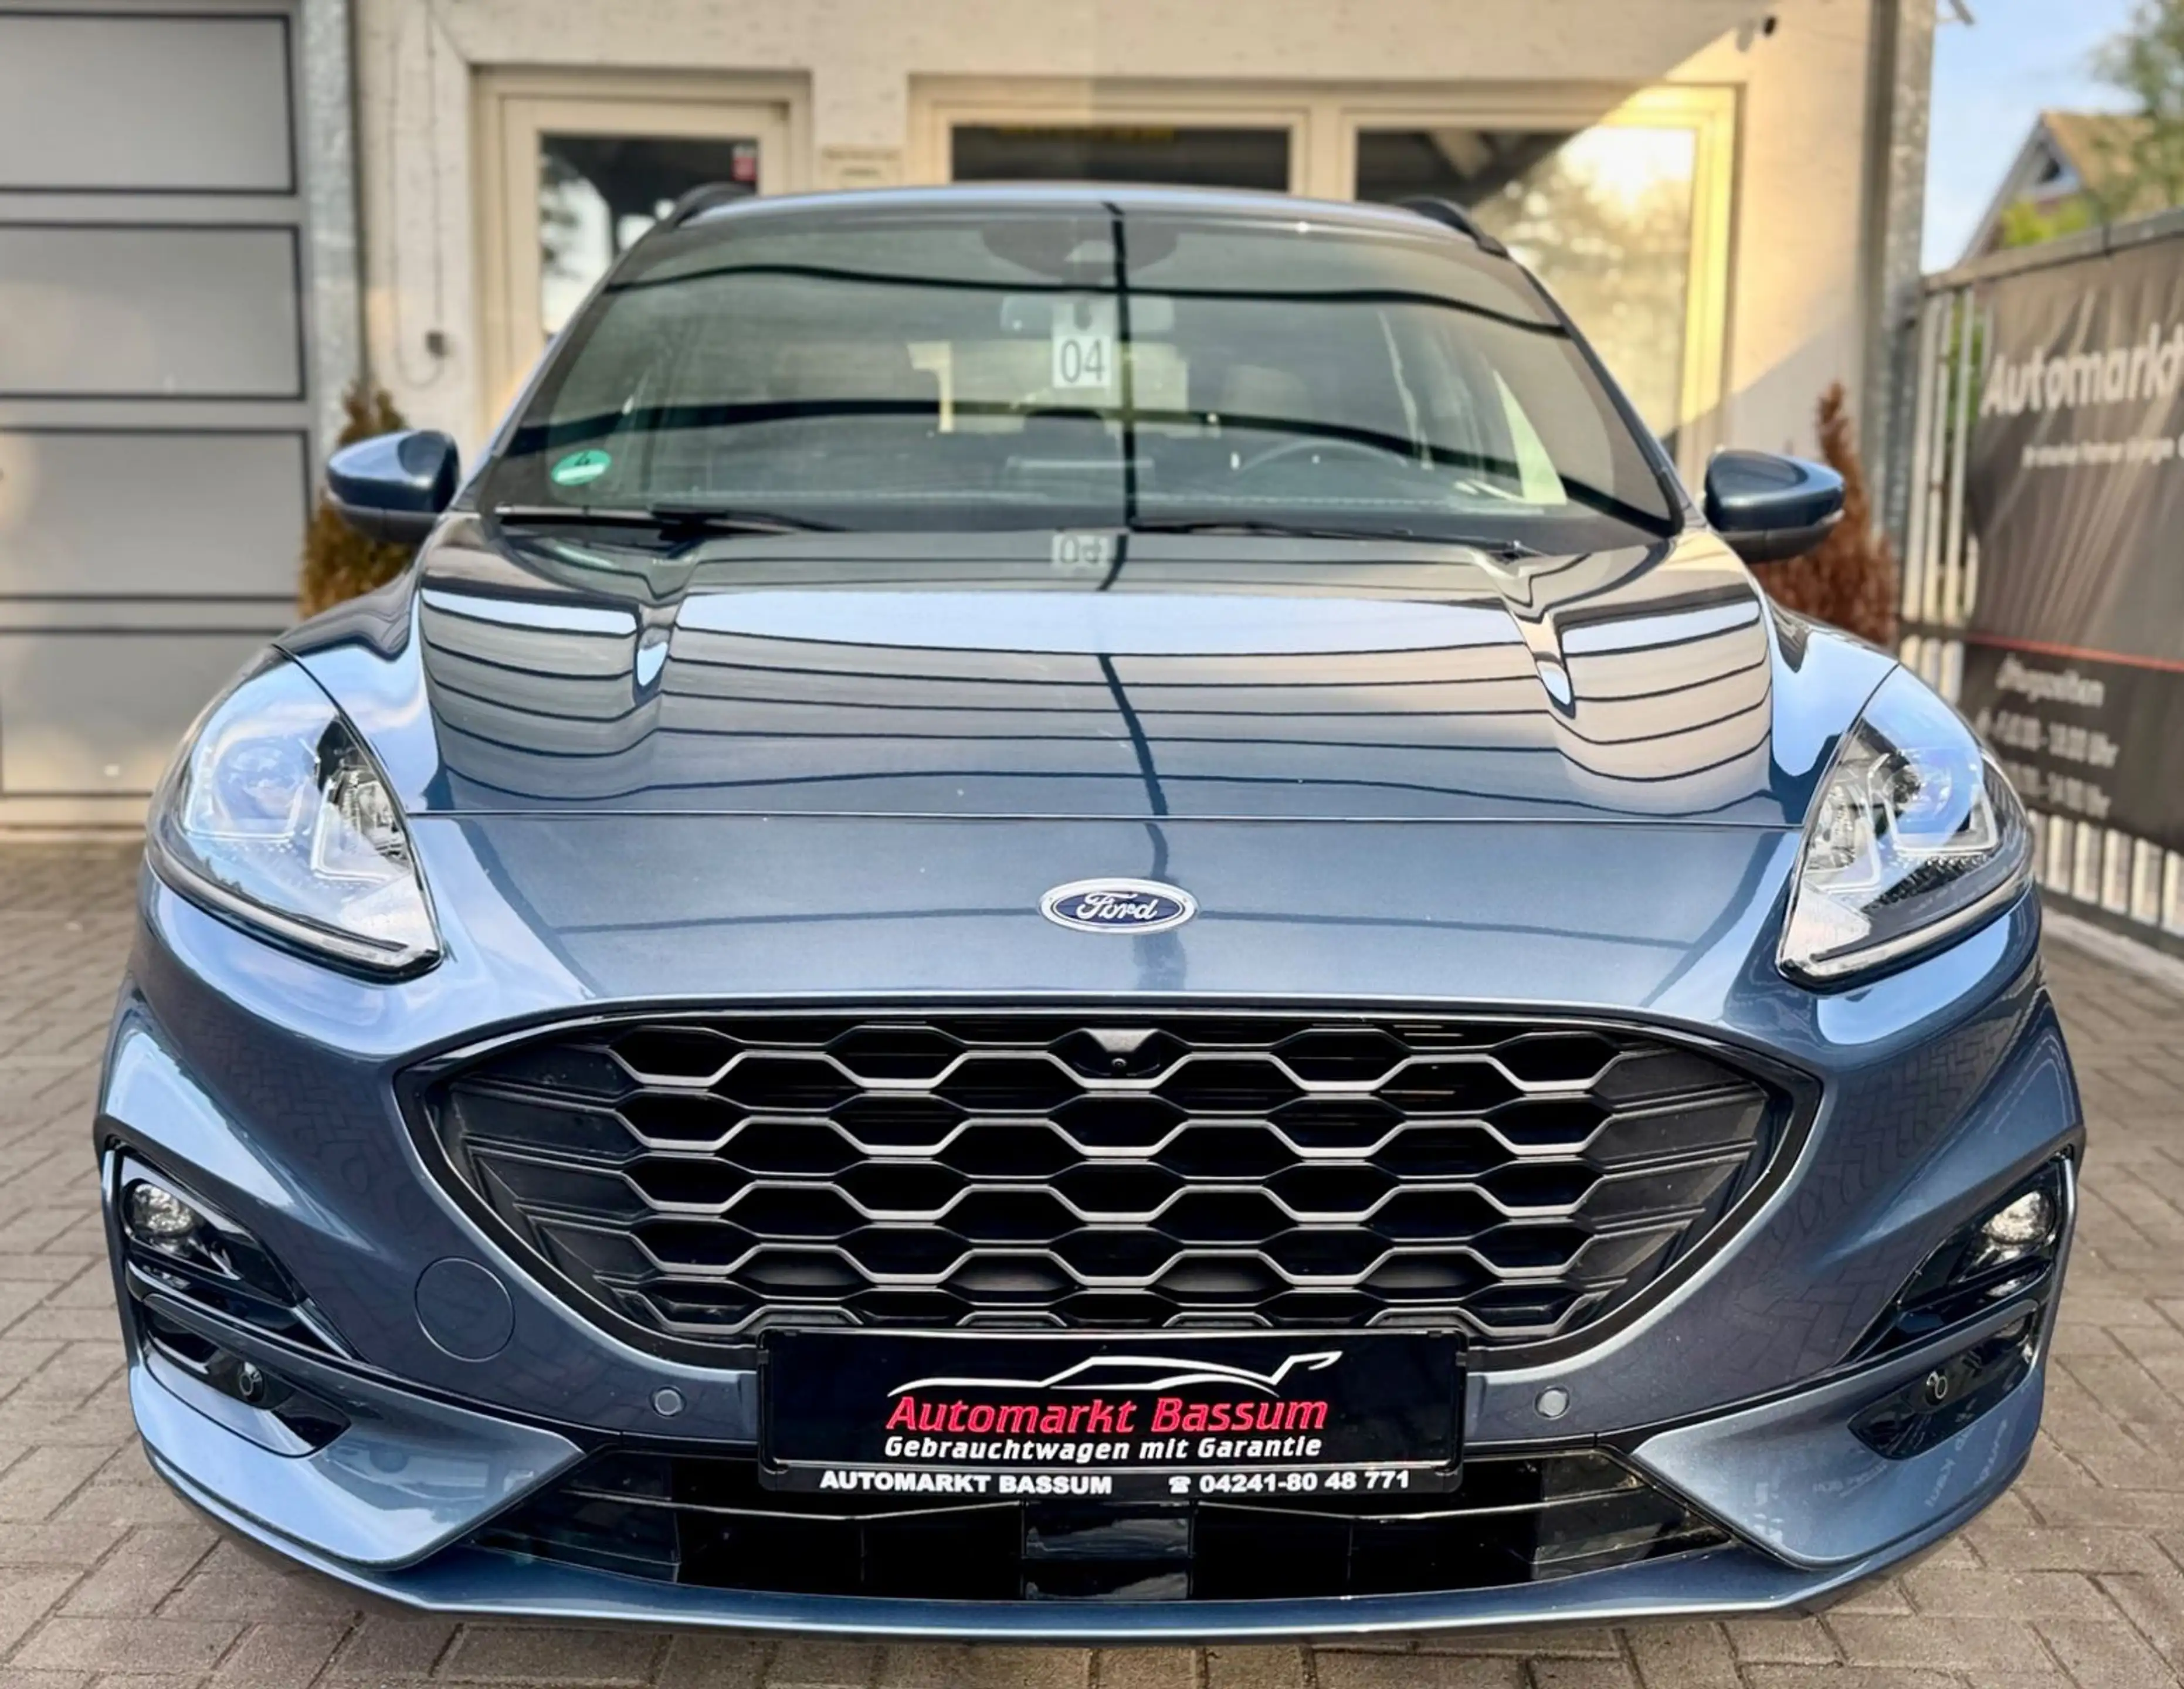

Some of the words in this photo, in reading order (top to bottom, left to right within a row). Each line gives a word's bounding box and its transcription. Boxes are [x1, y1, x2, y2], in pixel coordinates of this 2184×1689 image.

[1060, 338, 1105, 383] 04
[1076, 892, 1158, 920] Ford
[886, 1396, 1137, 1433] Automarkt
[1151, 1397, 1328, 1432] Bassum
[884, 1436, 1130, 1464] Gebrauchtwagen
[1140, 1438, 1188, 1459] mit
[1198, 1436, 1322, 1457] Garantie
[819, 1471, 991, 1493] AUTOMARKT
[999, 1475, 1112, 1494] BASSUM
[1199, 1473, 1318, 1493] 04241-80
[1324, 1472, 1356, 1490] 48
[1365, 1471, 1409, 1489] 771
